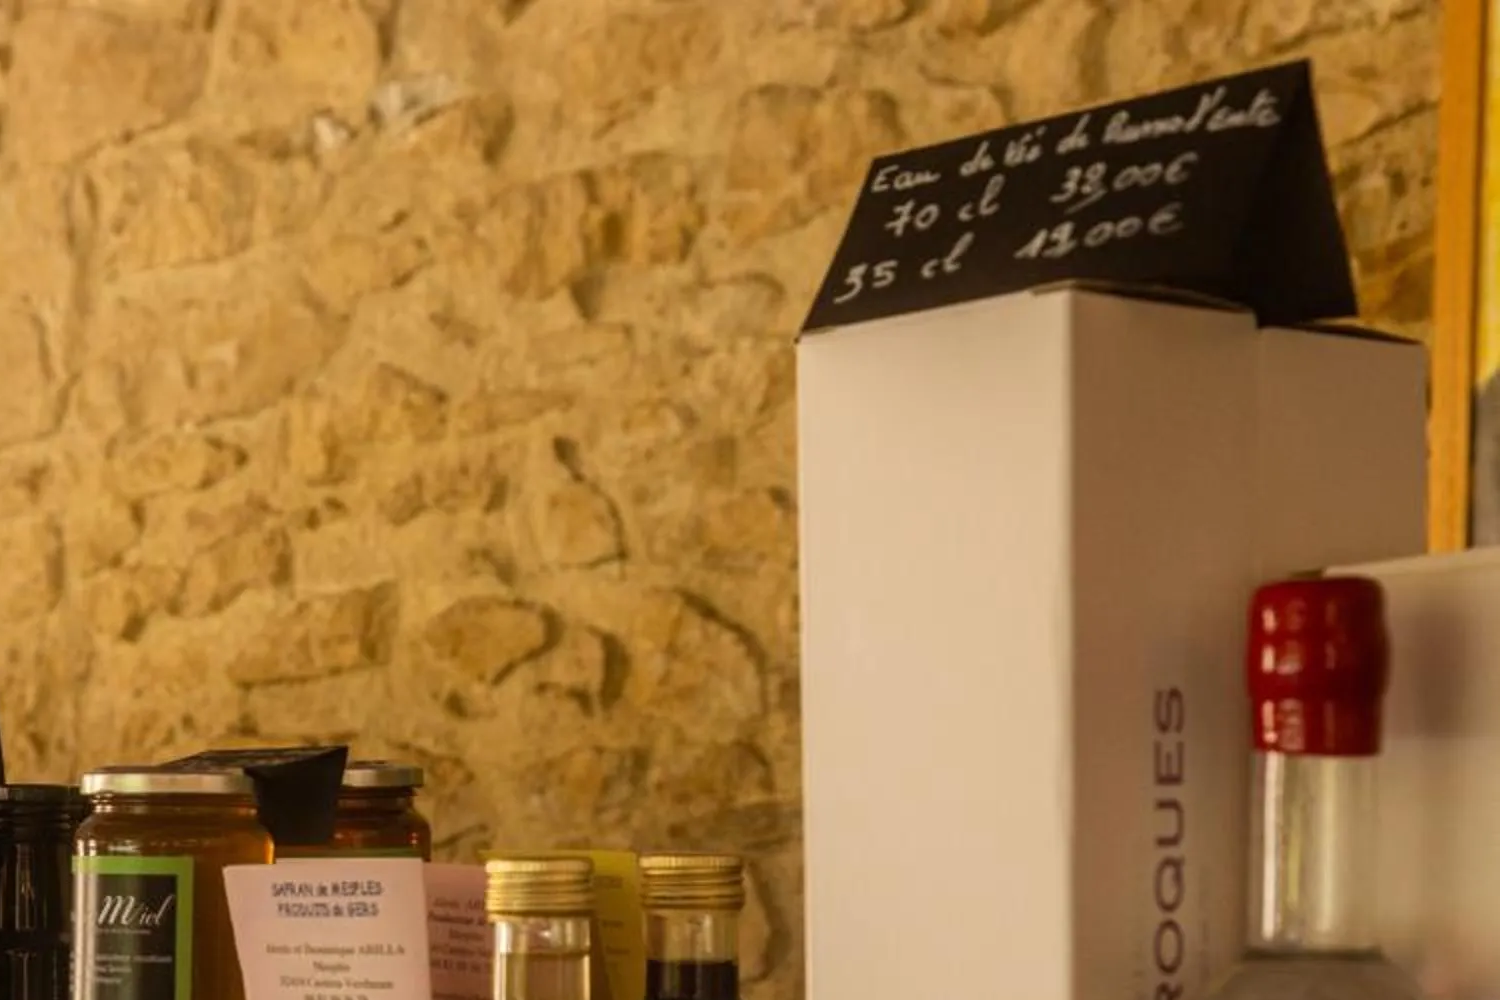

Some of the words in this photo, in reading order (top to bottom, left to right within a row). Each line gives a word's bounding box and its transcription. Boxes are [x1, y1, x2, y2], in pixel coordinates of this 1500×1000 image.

[870, 163, 941, 193] Eau
[884, 199, 940, 237] 70
[957, 173, 1006, 222] cl
[833, 261, 899, 304] 35
[920, 231, 976, 279] cl
[97, 895, 175, 926] Miel
